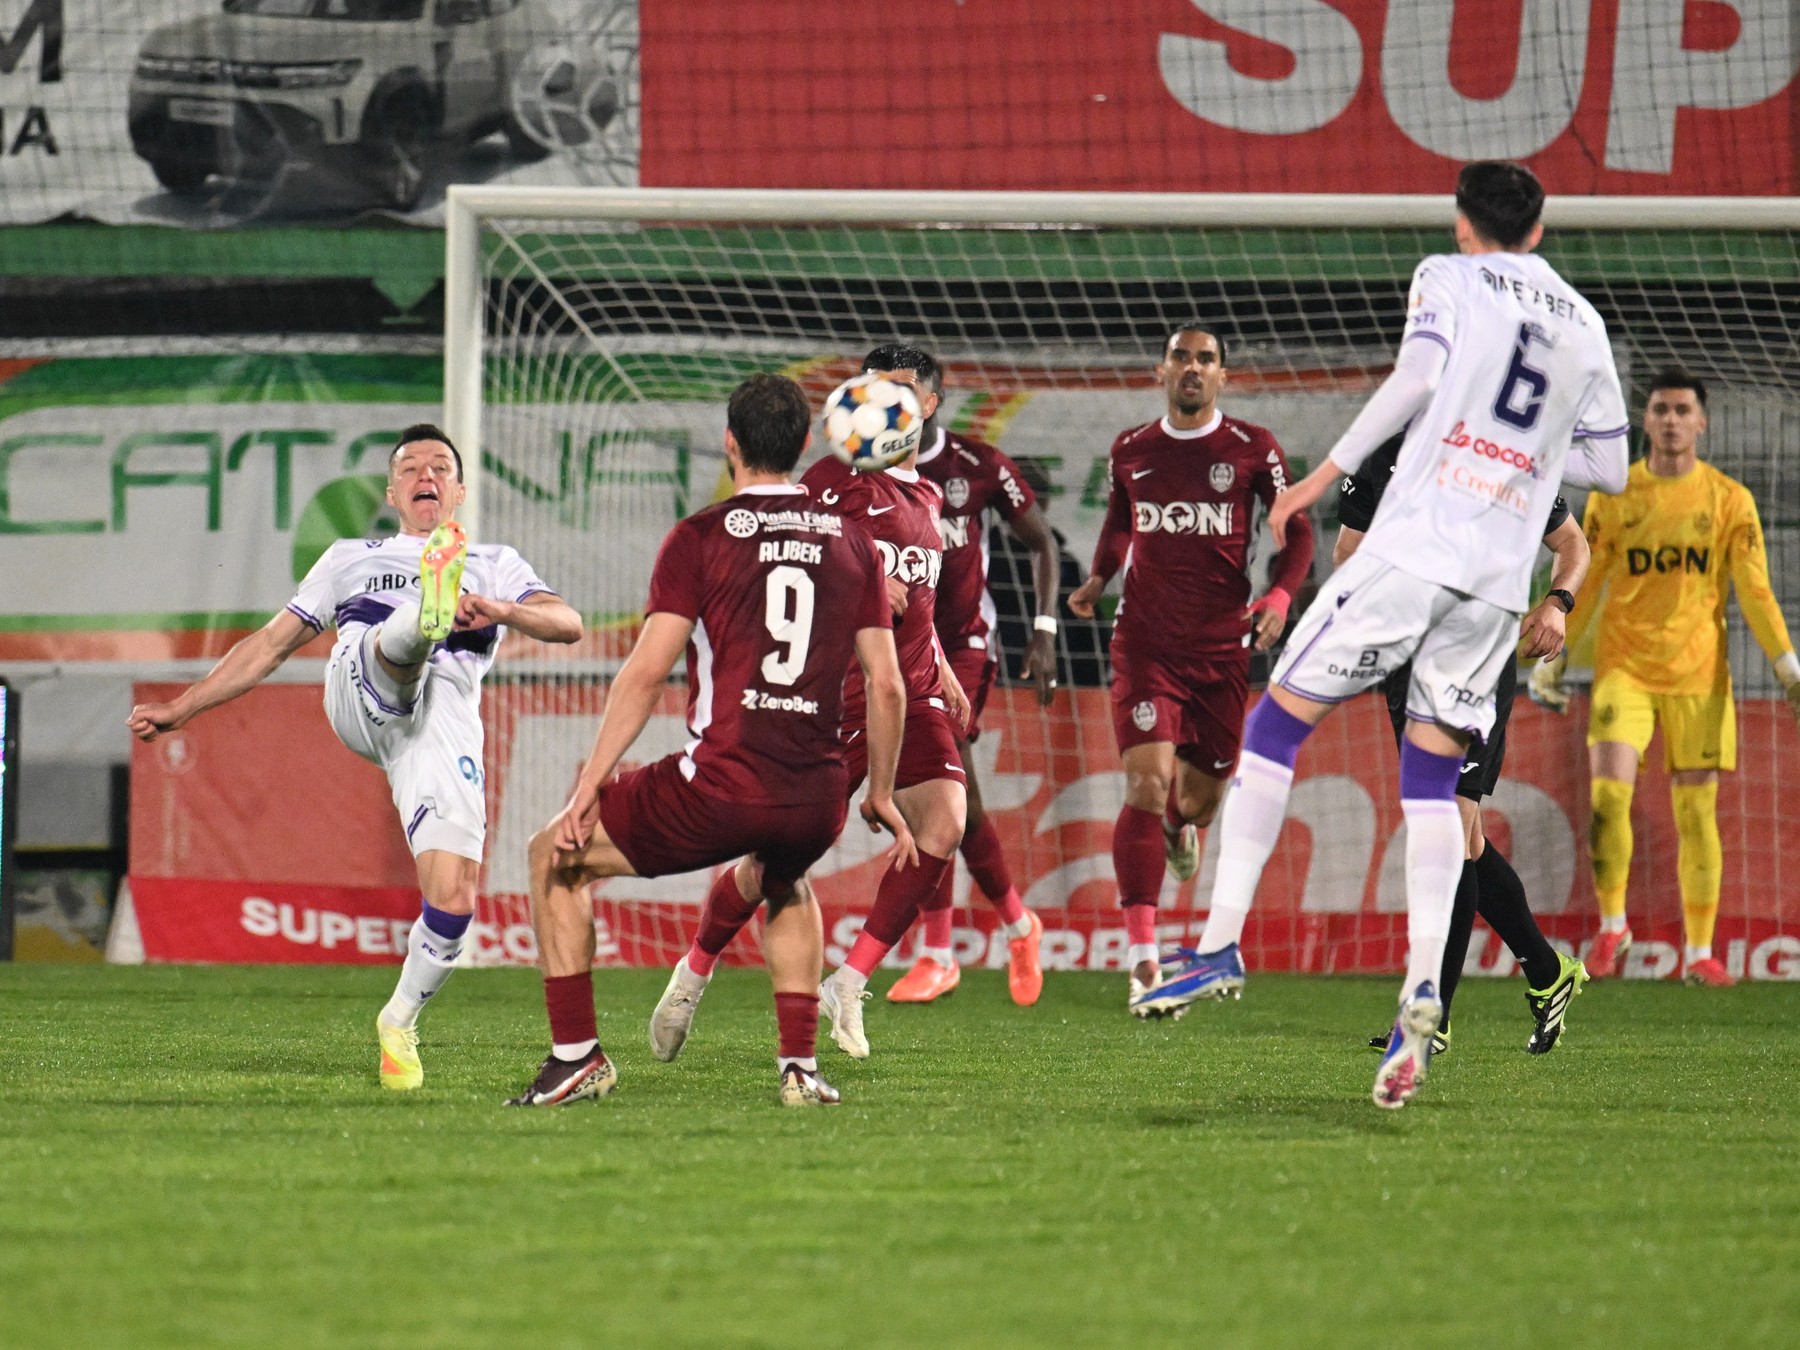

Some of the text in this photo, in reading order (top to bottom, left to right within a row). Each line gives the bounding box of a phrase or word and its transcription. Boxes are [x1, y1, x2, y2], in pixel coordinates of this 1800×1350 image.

[1491, 321, 1552, 433] 6
[1135, 501, 1234, 536] DON
[759, 540, 822, 564] ALIBEK
[1627, 547, 1709, 577] DON
[761, 565, 815, 686] 9
[758, 692, 818, 714] ZeroBet
